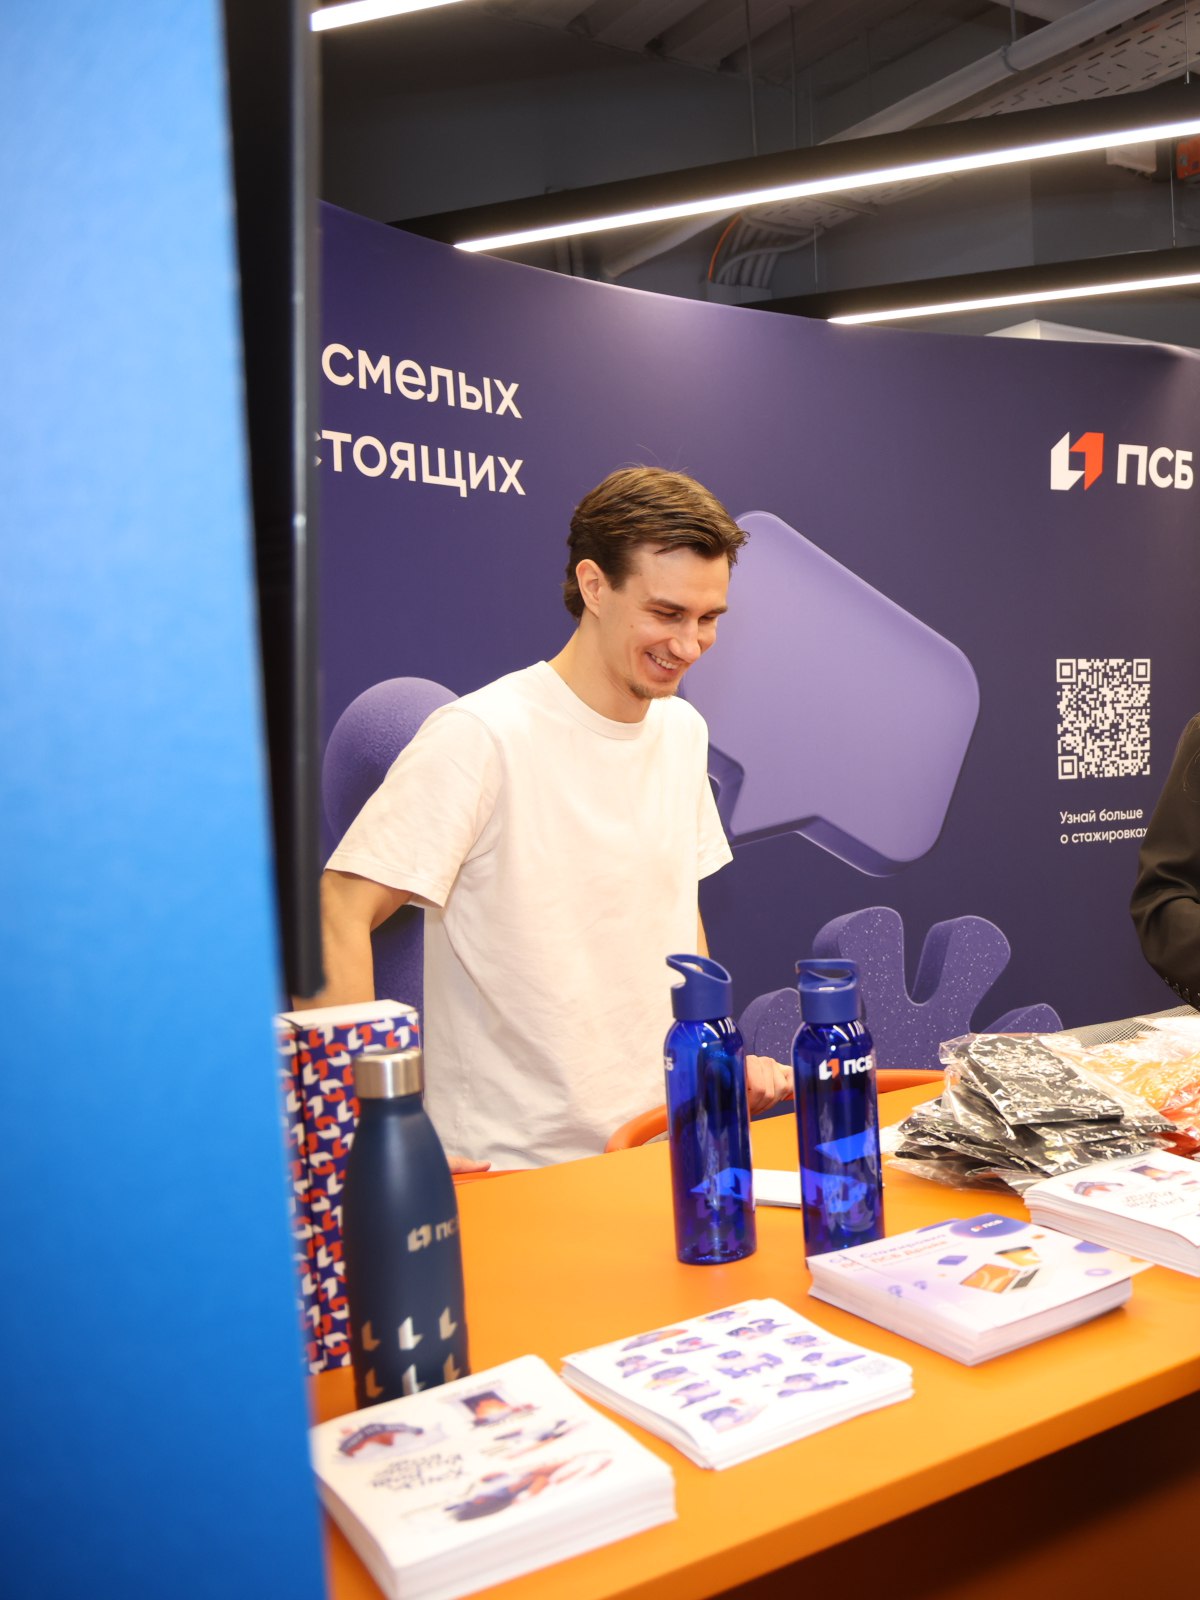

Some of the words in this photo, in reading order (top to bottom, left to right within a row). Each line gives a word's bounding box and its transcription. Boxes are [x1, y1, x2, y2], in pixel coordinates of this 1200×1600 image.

[321, 342, 523, 419] смелых
[314, 429, 527, 498] тоящих
[1116, 443, 1195, 490] ПСБ
[1059, 809, 1096, 825] Узнай
[1098, 808, 1144, 822] больше
[1060, 834, 1069, 844] о
[843, 1054, 874, 1076] ПСБ
[435, 1215, 459, 1242] ПС
